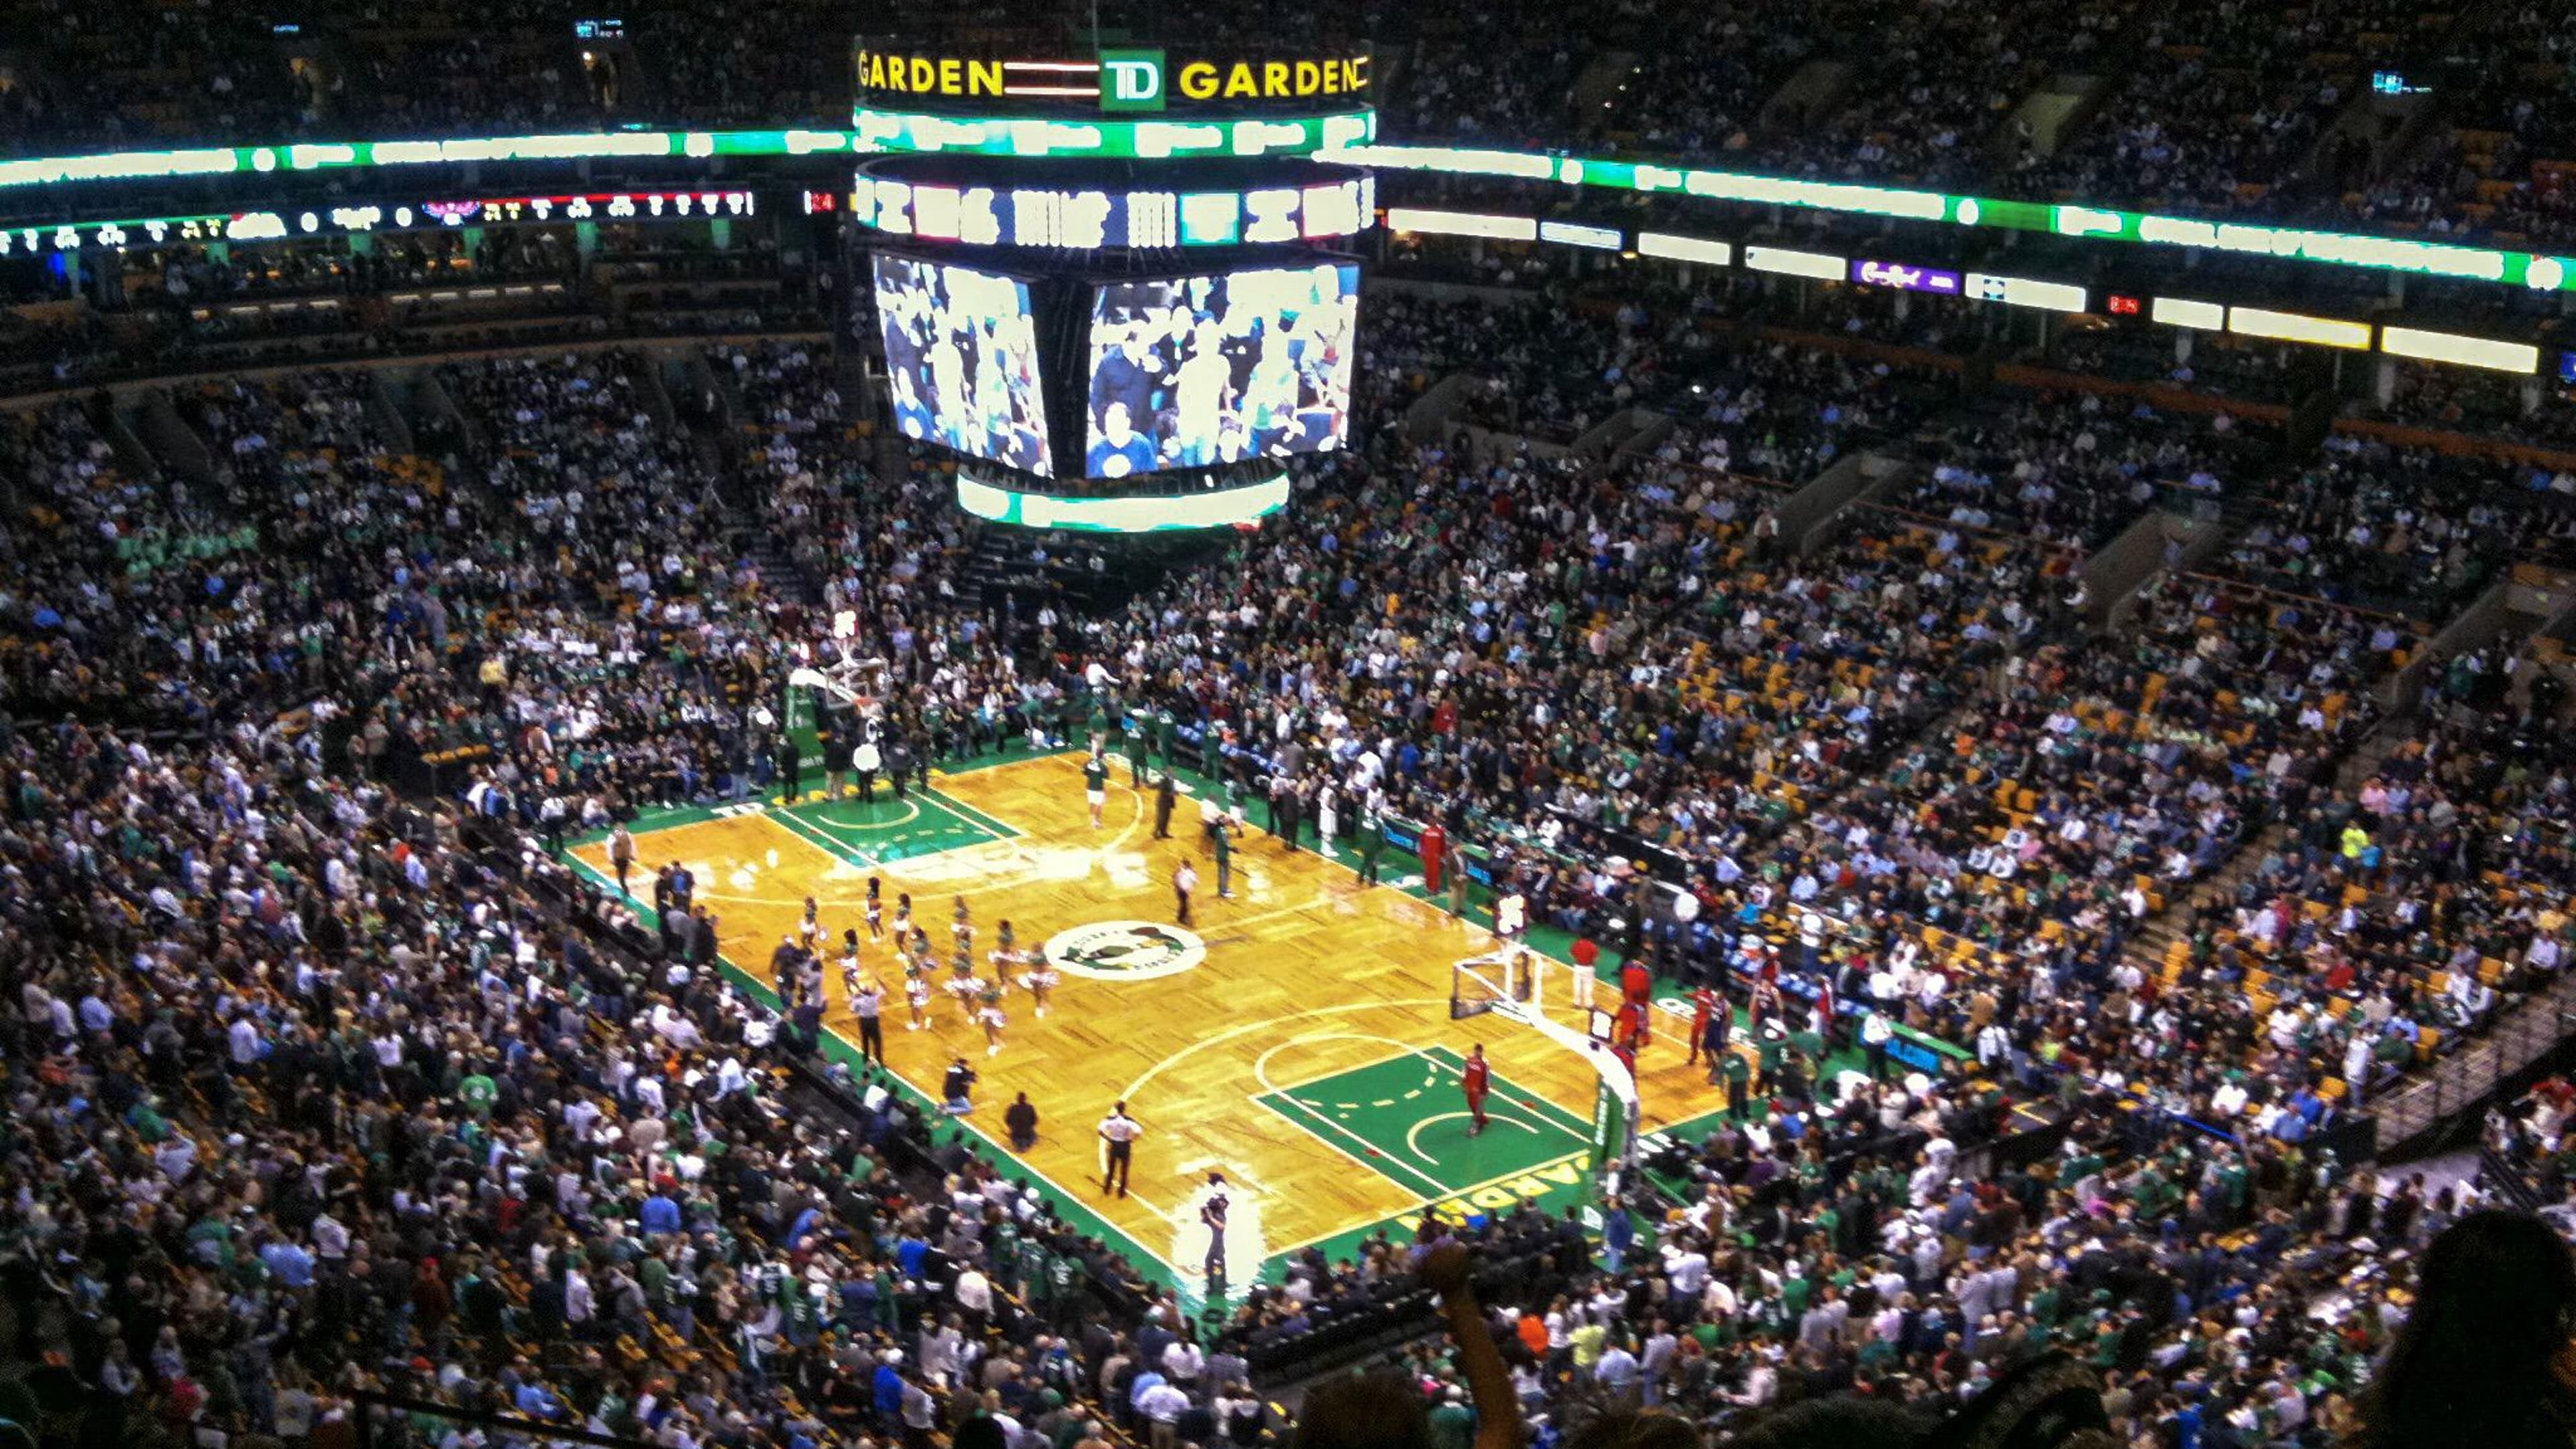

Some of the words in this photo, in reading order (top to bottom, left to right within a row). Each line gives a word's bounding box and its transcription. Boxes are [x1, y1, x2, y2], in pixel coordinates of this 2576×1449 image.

[858, 50, 1004, 96] GARDEN
[1106, 61, 1159, 100] TD
[1179, 58, 1358, 100] GARDEN
[710, 802, 765, 818] TD
